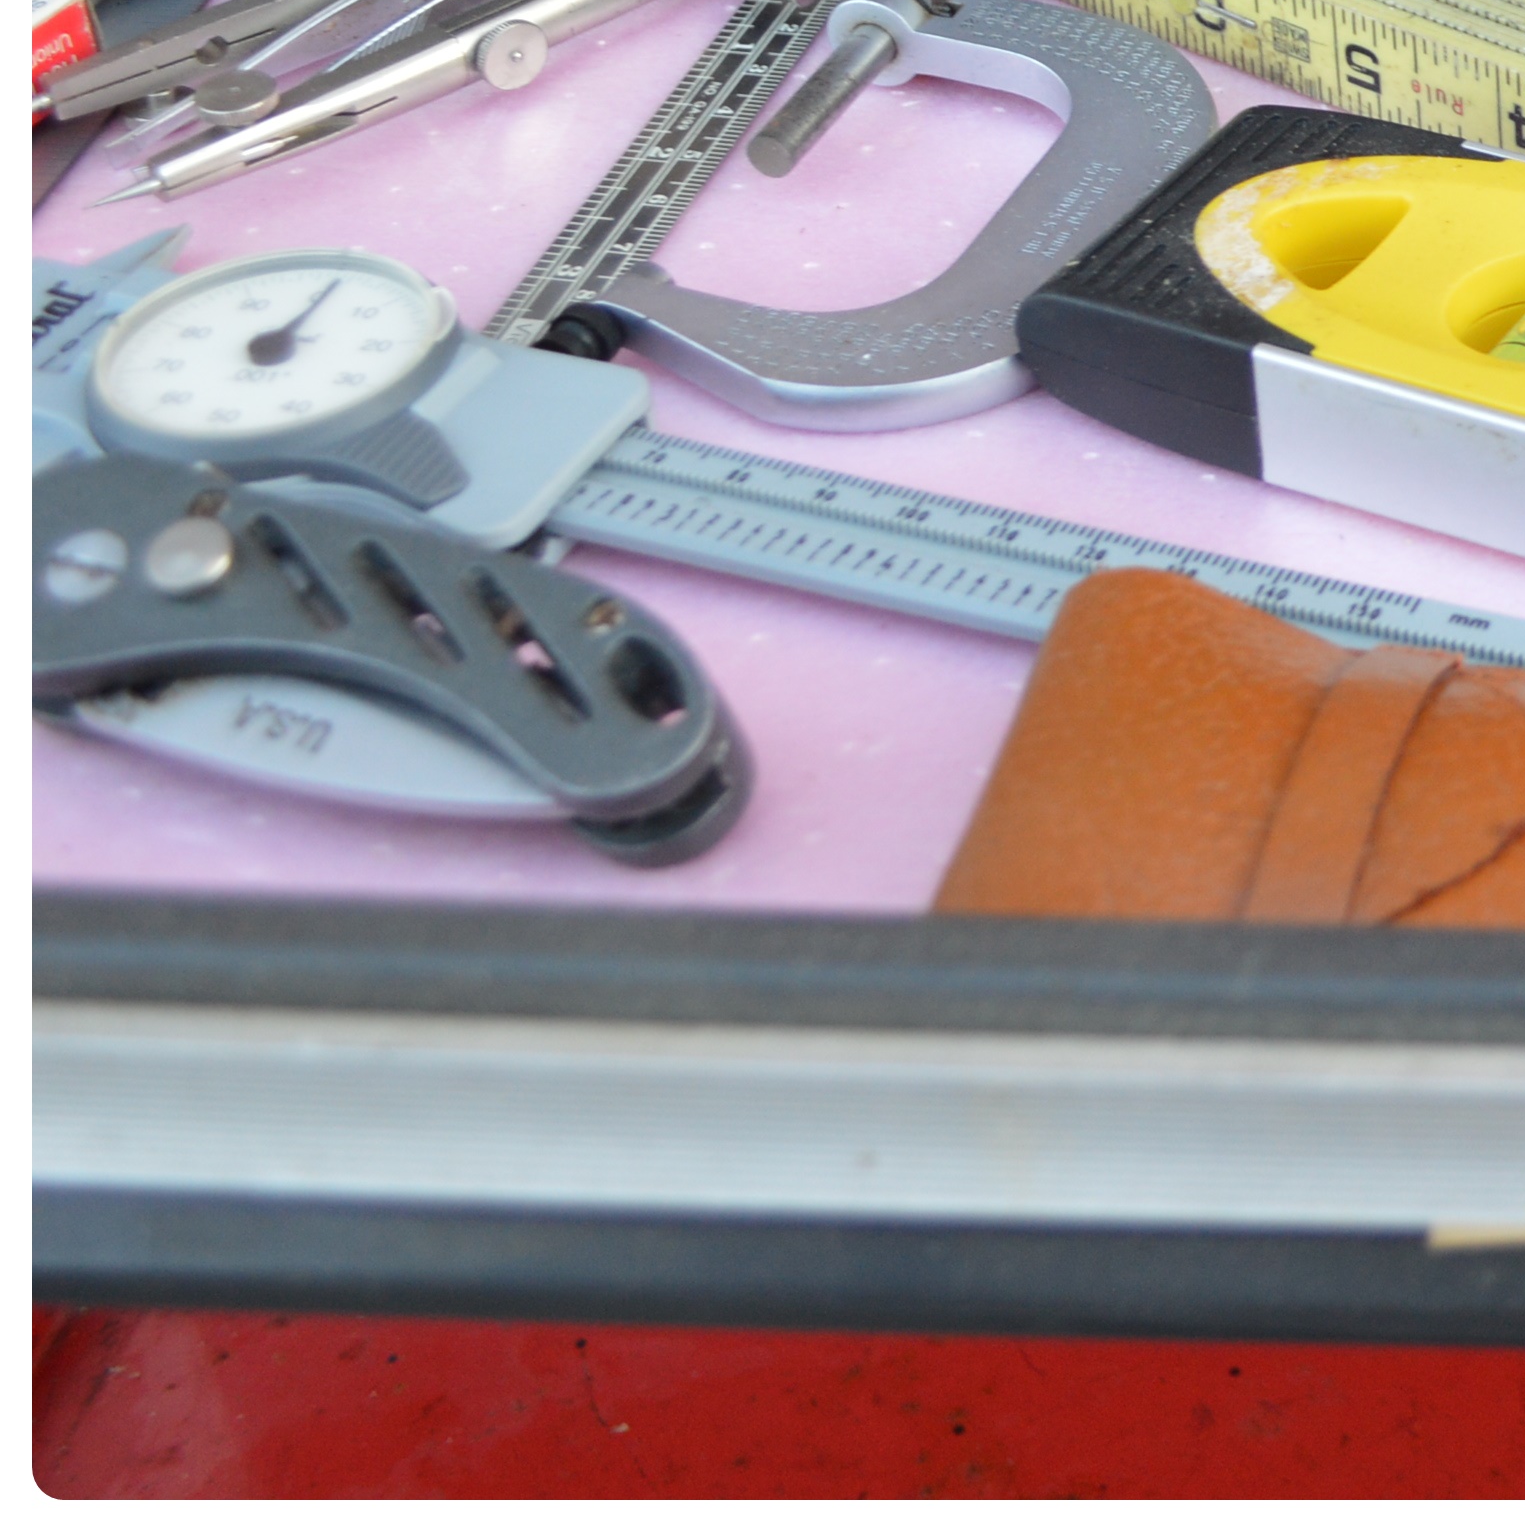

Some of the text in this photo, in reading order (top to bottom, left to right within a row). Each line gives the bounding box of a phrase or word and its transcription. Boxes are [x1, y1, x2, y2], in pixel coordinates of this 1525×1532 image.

[1345, 43, 1382, 95] 5
[1410, 78, 1465, 116] Rule
[351, 305, 380, 319] 10
[359, 338, 392, 353] 20
[153, 357, 186, 372] 70
[896, 506, 931, 522] 100
[1073, 544, 1108, 562] 120
[1254, 584, 1290, 601] 140
[1346, 602, 1382, 620] 150
[1448, 612, 1491, 631] mm
